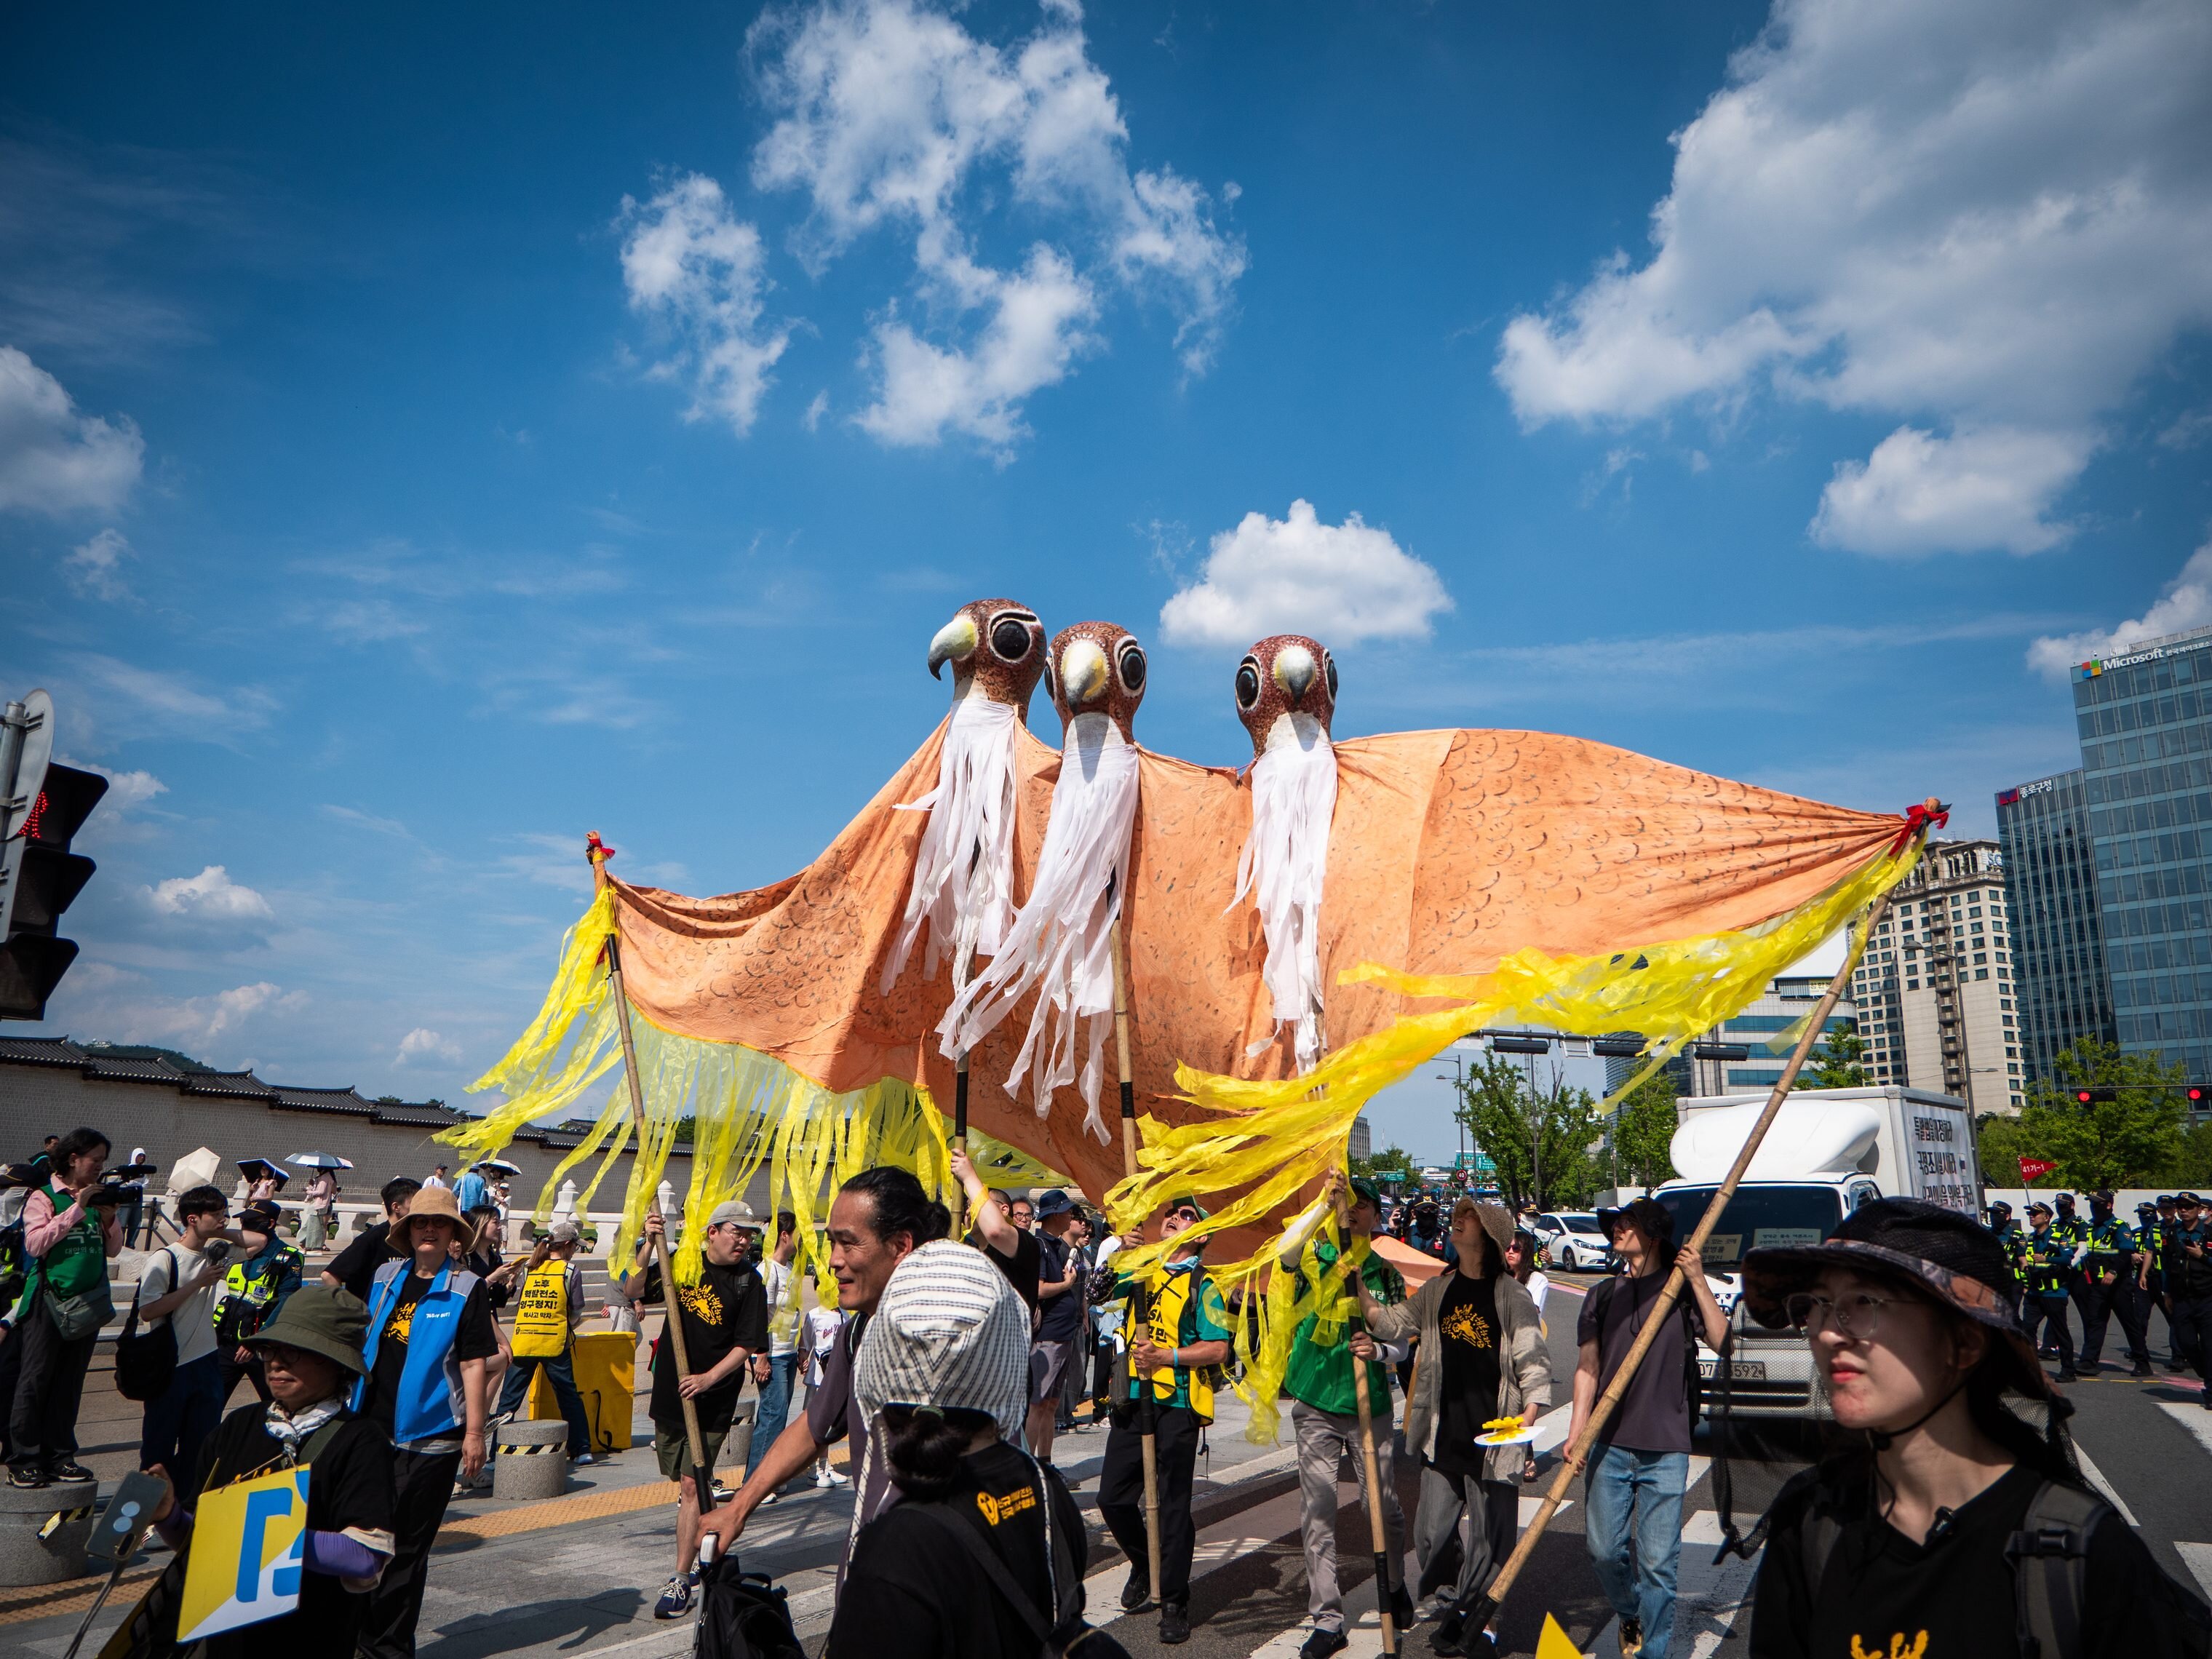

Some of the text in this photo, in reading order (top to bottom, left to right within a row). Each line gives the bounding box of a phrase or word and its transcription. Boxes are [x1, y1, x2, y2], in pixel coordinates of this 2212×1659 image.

[2103, 640, 2212, 670] Microsoft 한국마이크로소
[2020, 779, 2053, 798] 종로구청
[2023, 1163, 2045, 1173] 41기-1
[533, 1279, 550, 1288] 노후
[525, 1289, 558, 1298] 핵발전소
[520, 1300, 558, 1310] 영구정지!
[1734, 1365, 1759, 1378] 592
